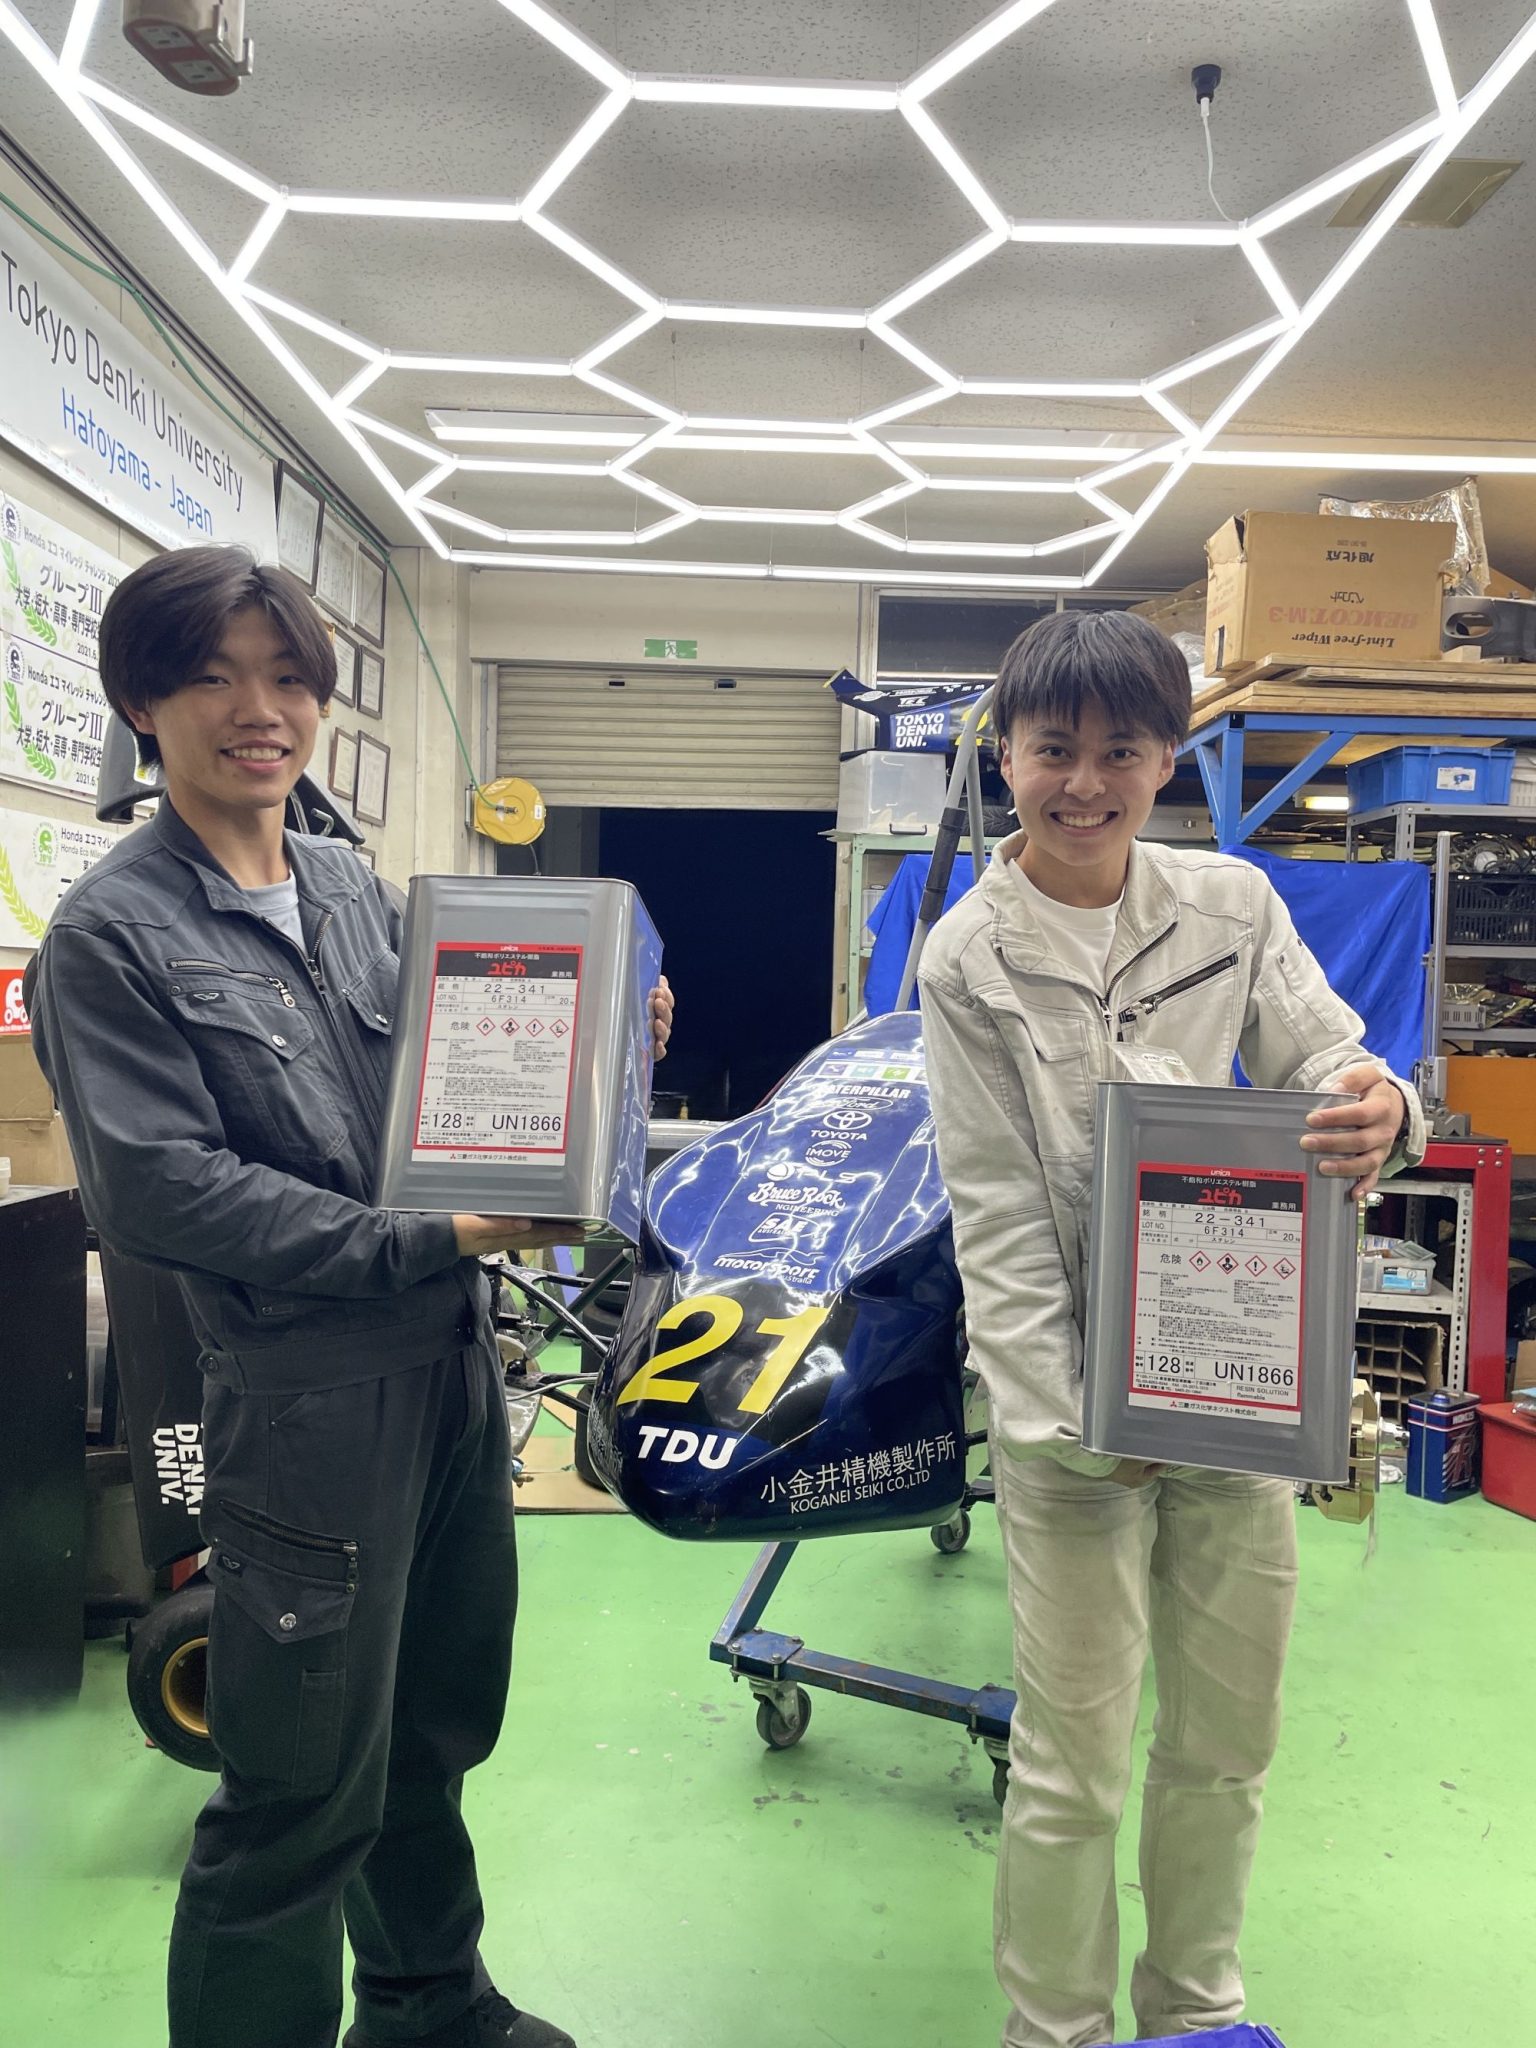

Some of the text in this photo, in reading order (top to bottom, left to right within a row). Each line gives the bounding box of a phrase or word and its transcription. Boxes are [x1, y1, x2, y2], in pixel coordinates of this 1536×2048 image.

[2, 251, 243, 512] Tokyo Denki University
[61, 386, 151, 491] Hatoyama
[169, 474, 214, 537] Japan
[24, 526, 46, 551] Honda
[1291, 631, 1396, 648] Lint-free Wiper
[28, 665, 48, 685] Honda
[895, 713, 945, 726] TOKYO
[895, 723, 944, 737] DENKI
[895, 736, 927, 748] UNI.
[61, 827, 83, 842] Honda
[491, 994, 527, 1004] 6F314
[559, 997, 569, 1005] 20
[432, 1113, 463, 1129] 128
[492, 1114, 562, 1132] UN1866
[810, 1129, 868, 1141] TOYOTA
[747, 1181, 846, 1210] Bruce Rock
[1198, 1187, 1243, 1205] ユピカ
[1271, 1202, 1297, 1211] 業務用
[761, 1217, 809, 1233] SAE
[1142, 1221, 1154, 1229] LOT
[1204, 1226, 1245, 1238] 6F314
[1283, 1233, 1295, 1241] 20
[713, 1257, 821, 1279] motorsport
[1160, 1253, 1182, 1265] 危険
[616, 1294, 832, 1416] 21
[1148, 1354, 1181, 1374] 128
[1214, 1361, 1294, 1387] UN1866
[1236, 1385, 1290, 1397] RESIN SOLUTION
[637, 1425, 738, 1470] TDU
[152, 1428, 185, 1504] UNIV.
[174, 1424, 205, 1515] DENKI
[760, 1432, 957, 1504] 小金井精機製作所
[790, 1485, 852, 1514] KOGANEI
[855, 1477, 885, 1499] SEIKI
